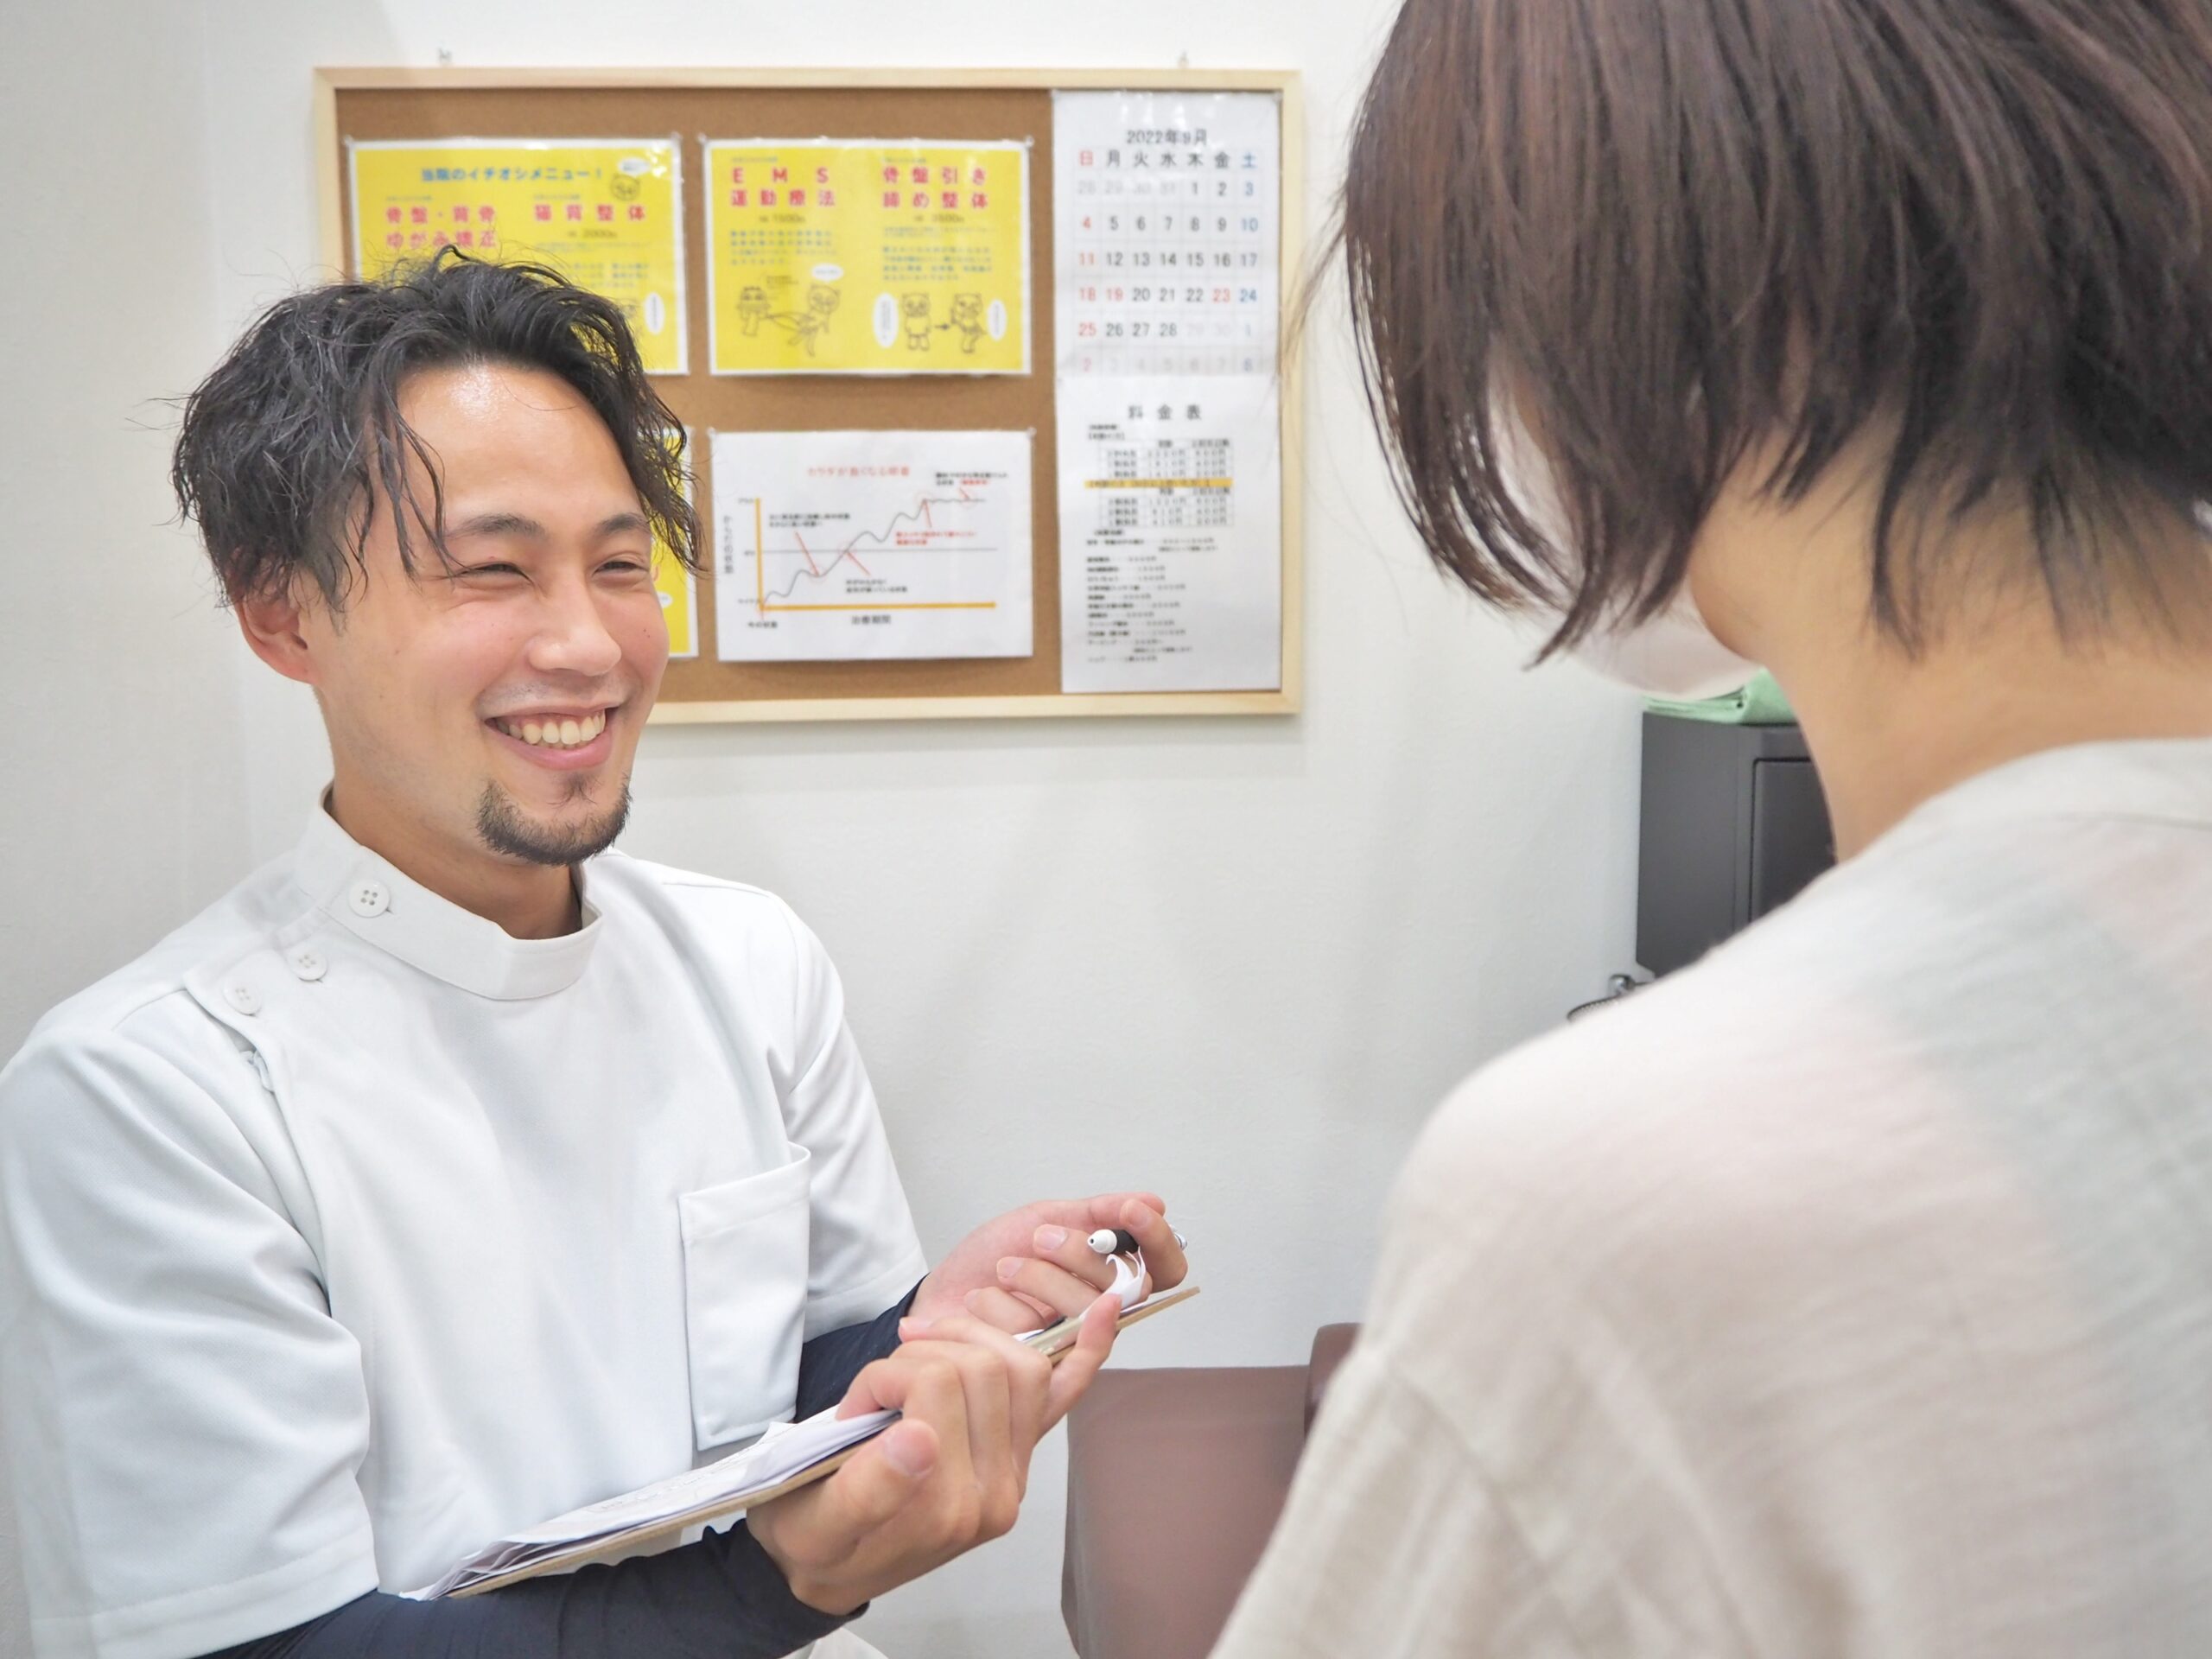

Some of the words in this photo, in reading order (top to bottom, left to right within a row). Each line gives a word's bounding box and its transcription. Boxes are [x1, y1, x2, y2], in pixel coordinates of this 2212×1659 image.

[1126, 129, 1208, 146] 2022年9月
[1079, 151, 1093, 168] 日
[1106, 151, 1120, 168] 月
[1133, 151, 1149, 168] 火
[1160, 151, 1177, 168] 水
[1186, 151, 1204, 168] 木
[1214, 151, 1230, 168] 金
[1242, 151, 1257, 168] 土
[883, 167, 987, 184] 骨盤引き
[1192, 181, 1198, 195] 1
[1218, 181, 1227, 195] 2
[1245, 181, 1254, 195] 3
[732, 189, 836, 207] 運動療法
[883, 192, 988, 209] 締め整体
[385, 206, 495, 224] 骨盤・背骨
[534, 204, 646, 222] 猫背整体
[1082, 216, 1091, 232] 4
[1109, 216, 1119, 232] 5
[1136, 216, 1146, 232] 6
[1164, 216, 1173, 232] 7
[1191, 216, 1200, 232] 8
[1217, 216, 1227, 232] 9
[1242, 216, 1258, 232] 10
[386, 230, 497, 249] ゆがみ矯正
[1079, 251, 1096, 267] 11
[1106, 251, 1123, 267] 12
[1133, 251, 1150, 267] 13
[1160, 251, 1177, 267] 14
[1187, 251, 1204, 267] 15
[1214, 251, 1231, 267] 16
[1241, 251, 1257, 267] 17
[1079, 287, 1096, 302] 18
[1106, 287, 1123, 302] 19
[1132, 287, 1150, 302] 20
[1160, 287, 1175, 302] 21
[1186, 287, 1204, 302] 22
[1212, 287, 1230, 302] 23
[1239, 287, 1256, 302] 24
[1078, 322, 1096, 337] 25
[1106, 322, 1123, 337] 26
[1133, 322, 1150, 337] 27
[1160, 322, 1177, 337] 28
[1128, 404, 1203, 421] 料金表
